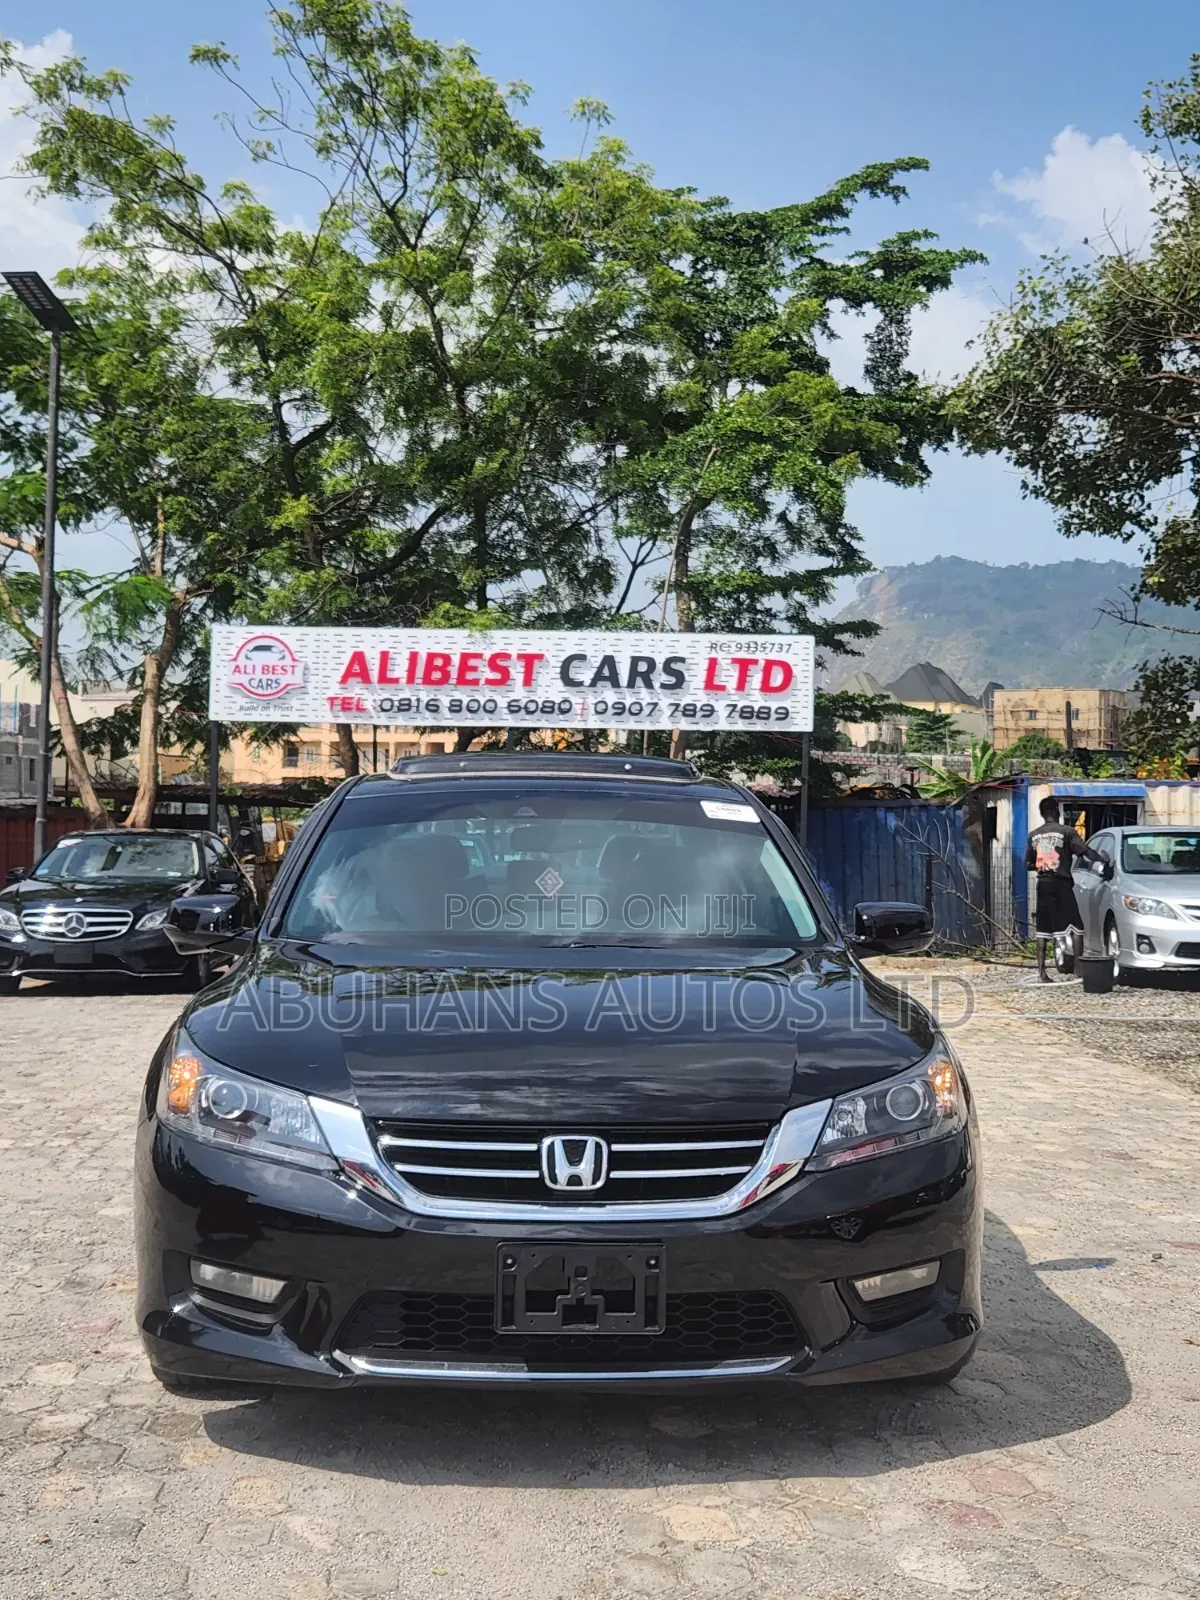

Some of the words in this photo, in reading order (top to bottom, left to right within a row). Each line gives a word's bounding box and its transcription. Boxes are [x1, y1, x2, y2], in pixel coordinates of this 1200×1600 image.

[735, 642, 793, 654] 9335737
[232, 664, 256, 675] ALI
[261, 664, 298, 675] BEST
[339, 650, 545, 687] ALIBEST
[559, 653, 686, 690] CARS
[703, 656, 793, 694] LTD
[248, 677, 282, 690] CARS
[238, 704, 259, 712] Build
[273, 704, 294, 712] Trust
[380, 697, 441, 713] 0816
[448, 698, 498, 714] 800
[507, 699, 573, 715] 6080
[594, 700, 659, 717] 0907
[668, 702, 716, 719] 789
[725, 703, 790, 721] 7889
